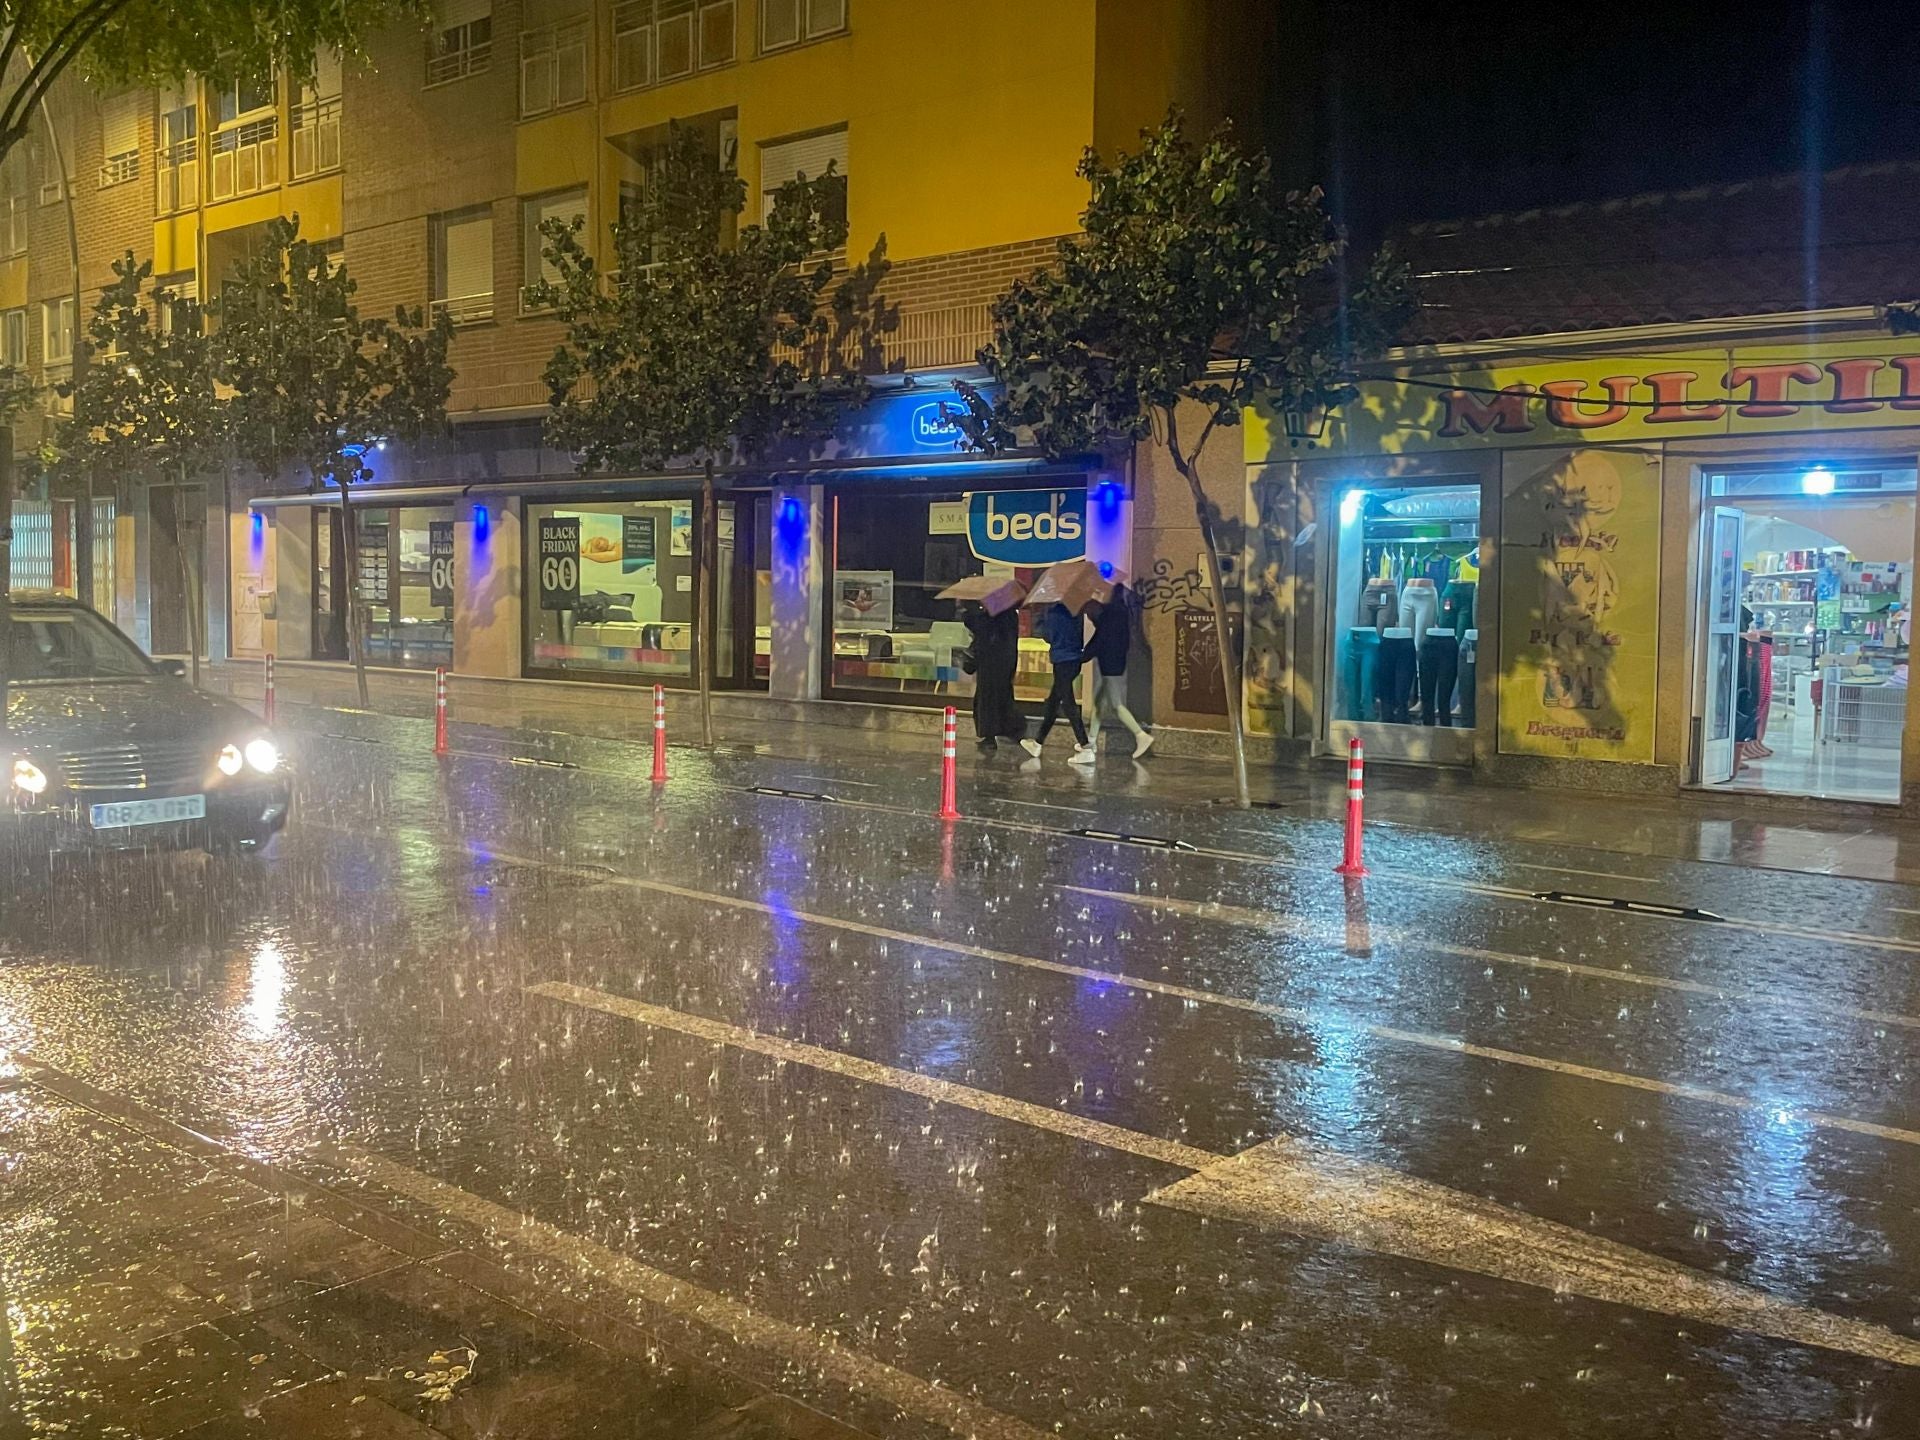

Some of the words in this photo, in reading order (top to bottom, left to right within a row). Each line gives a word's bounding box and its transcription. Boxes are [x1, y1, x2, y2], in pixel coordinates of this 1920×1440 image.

[987, 493, 1081, 540] bed's
[433, 530, 454, 541] BLAC
[543, 527, 576, 539] BLACK
[432, 543, 454, 554] FRID
[542, 540, 577, 553] FRIDAY
[542, 556, 577, 591] 60
